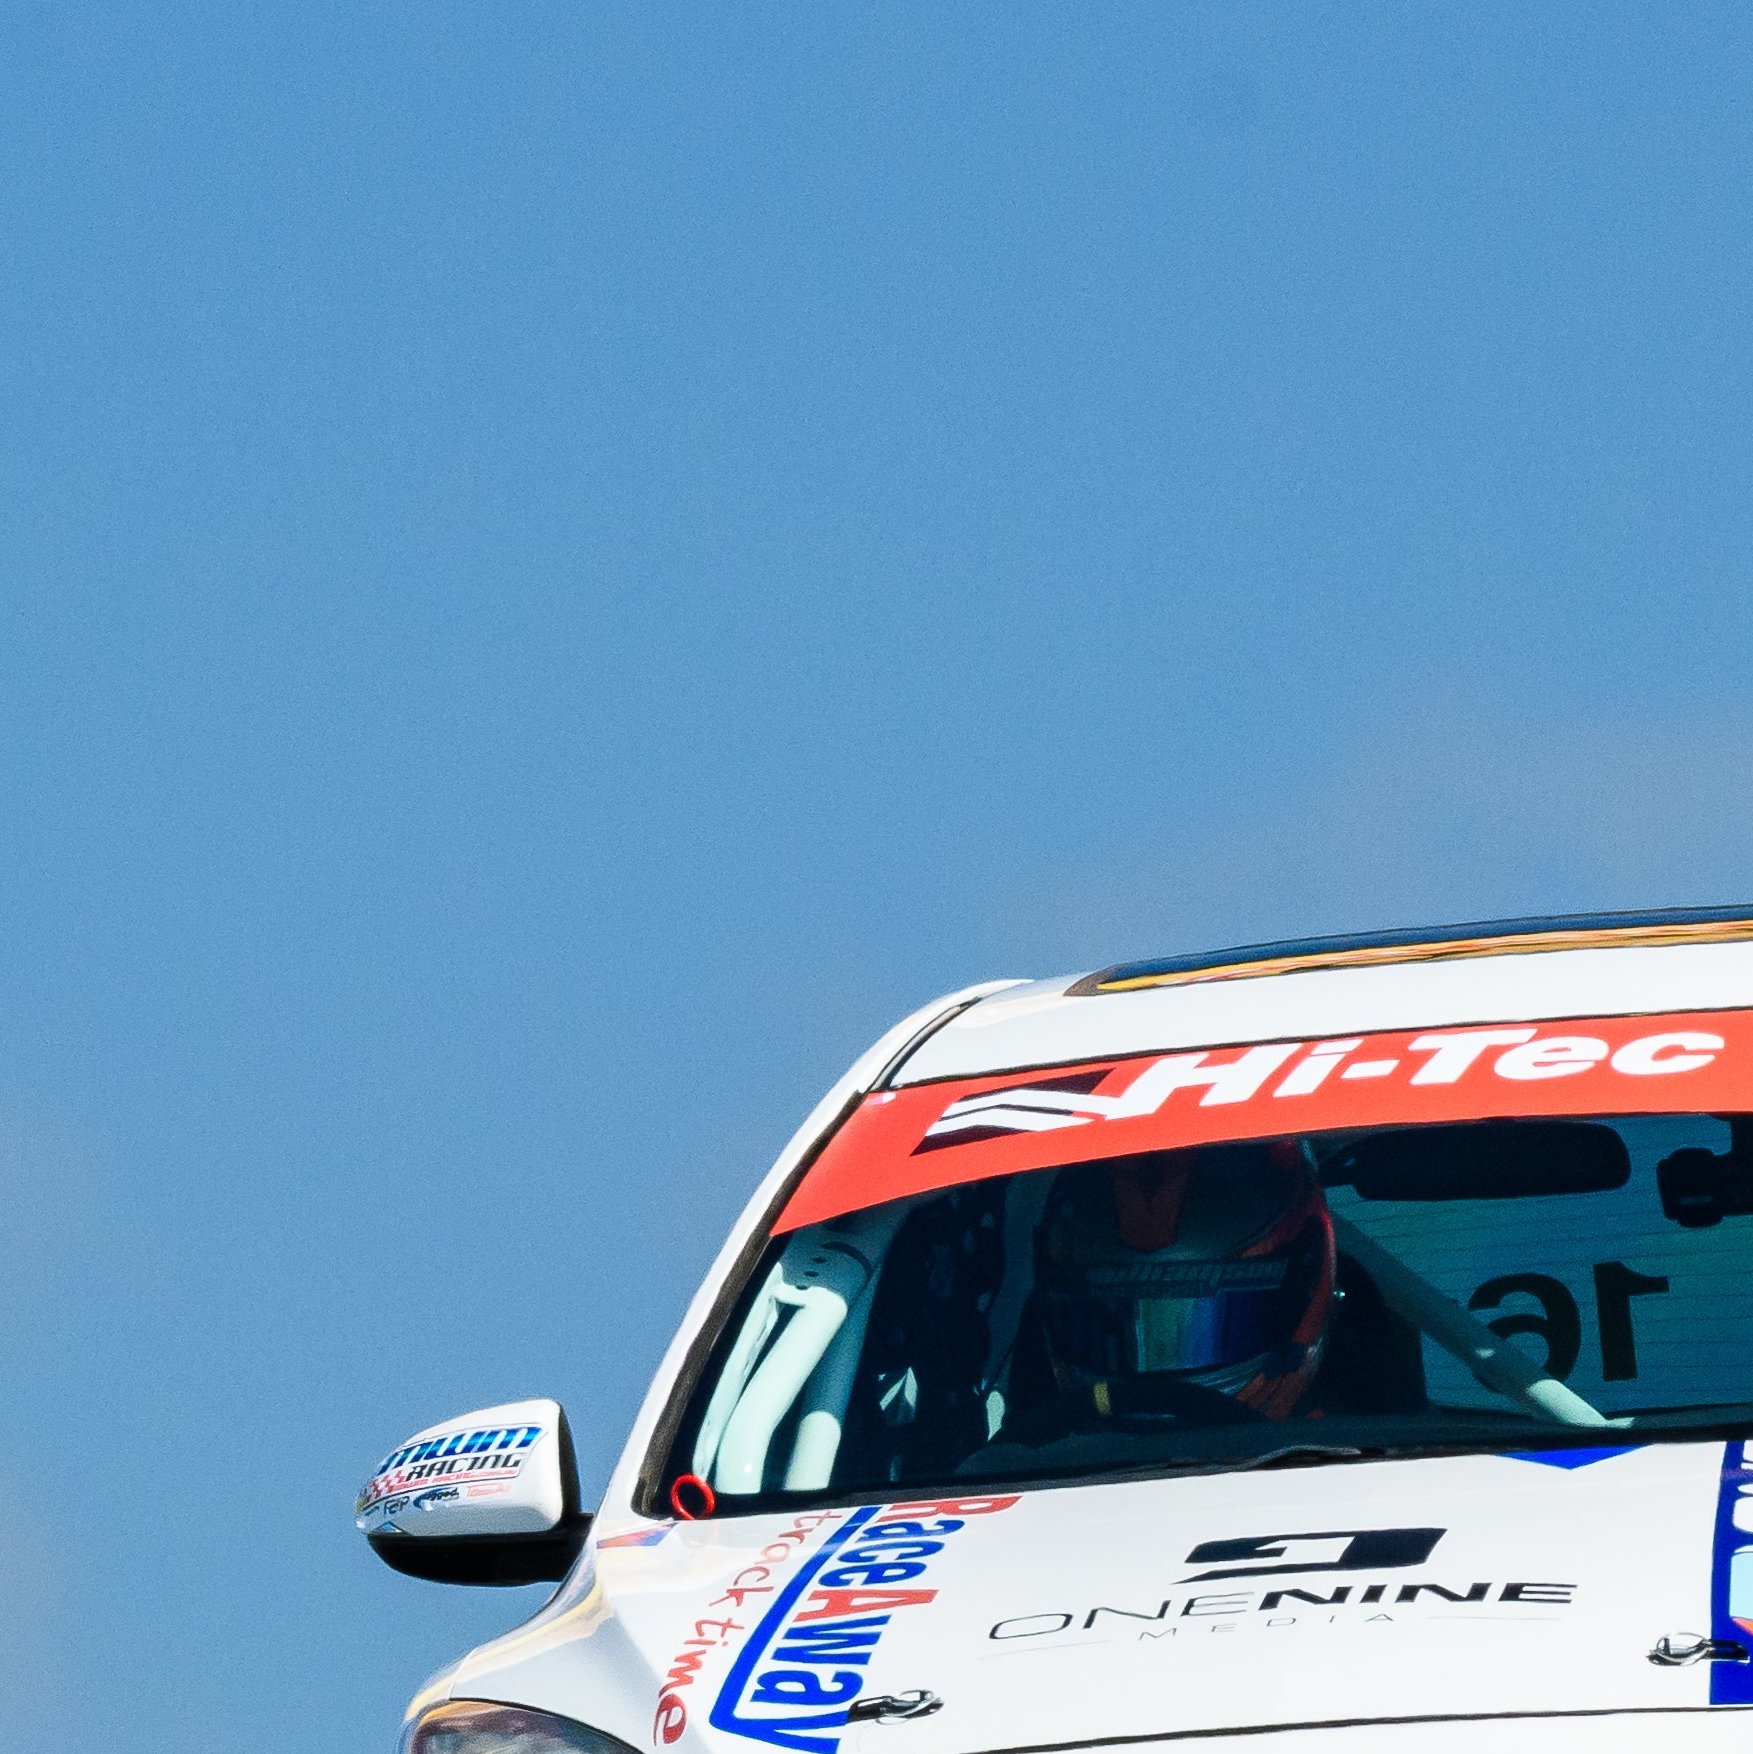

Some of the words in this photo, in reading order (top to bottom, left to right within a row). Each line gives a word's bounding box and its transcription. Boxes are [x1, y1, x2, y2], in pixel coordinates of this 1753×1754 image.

[1104, 1028, 1725, 1120] Hi-Tec
[406, 1453, 526, 1482] RACING
[708, 1510, 842, 1607] track
[989, 1582, 1578, 1640] ONENINE
[1138, 1613, 1396, 1642] MEDIA
[653, 1617, 746, 1747] time
